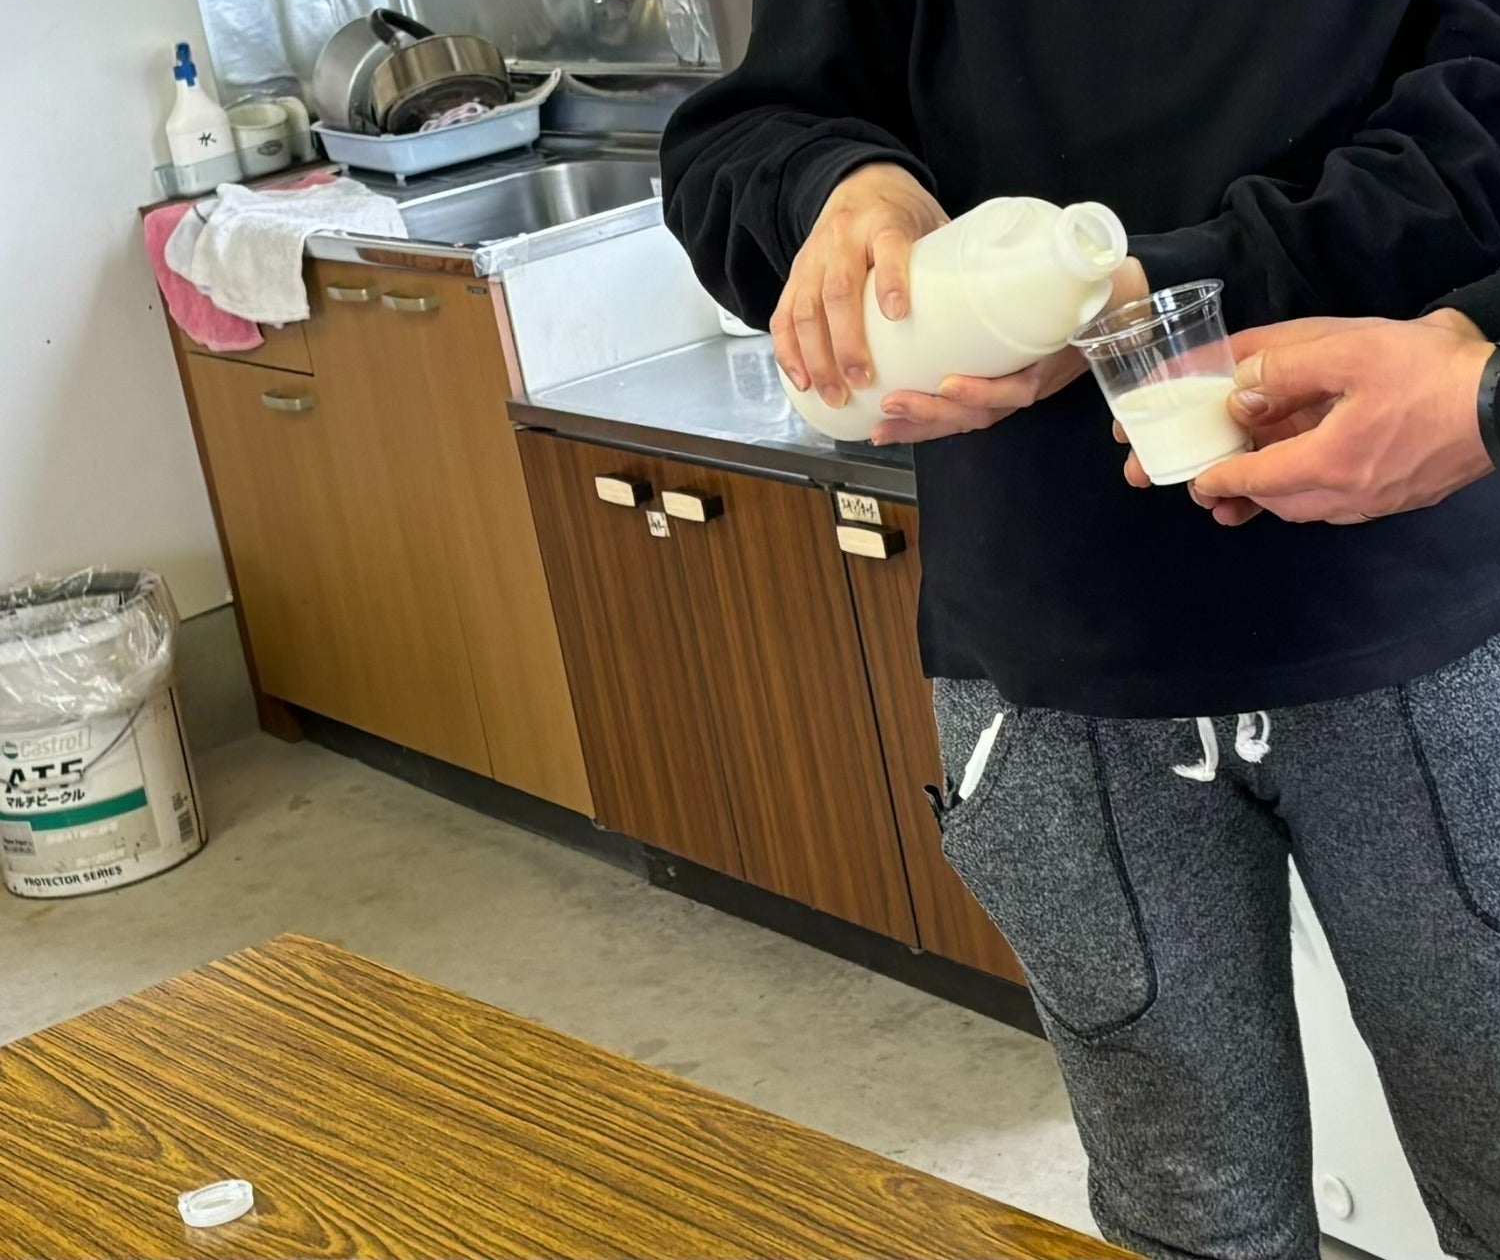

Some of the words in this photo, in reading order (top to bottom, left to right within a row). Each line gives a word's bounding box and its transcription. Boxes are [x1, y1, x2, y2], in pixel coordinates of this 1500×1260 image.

[21, 729, 82, 759] Castrol
[5, 788, 85, 809] マルチビークル
[23, 874, 82, 888] PROTECTOR
[83, 865, 123, 883] SERIES
